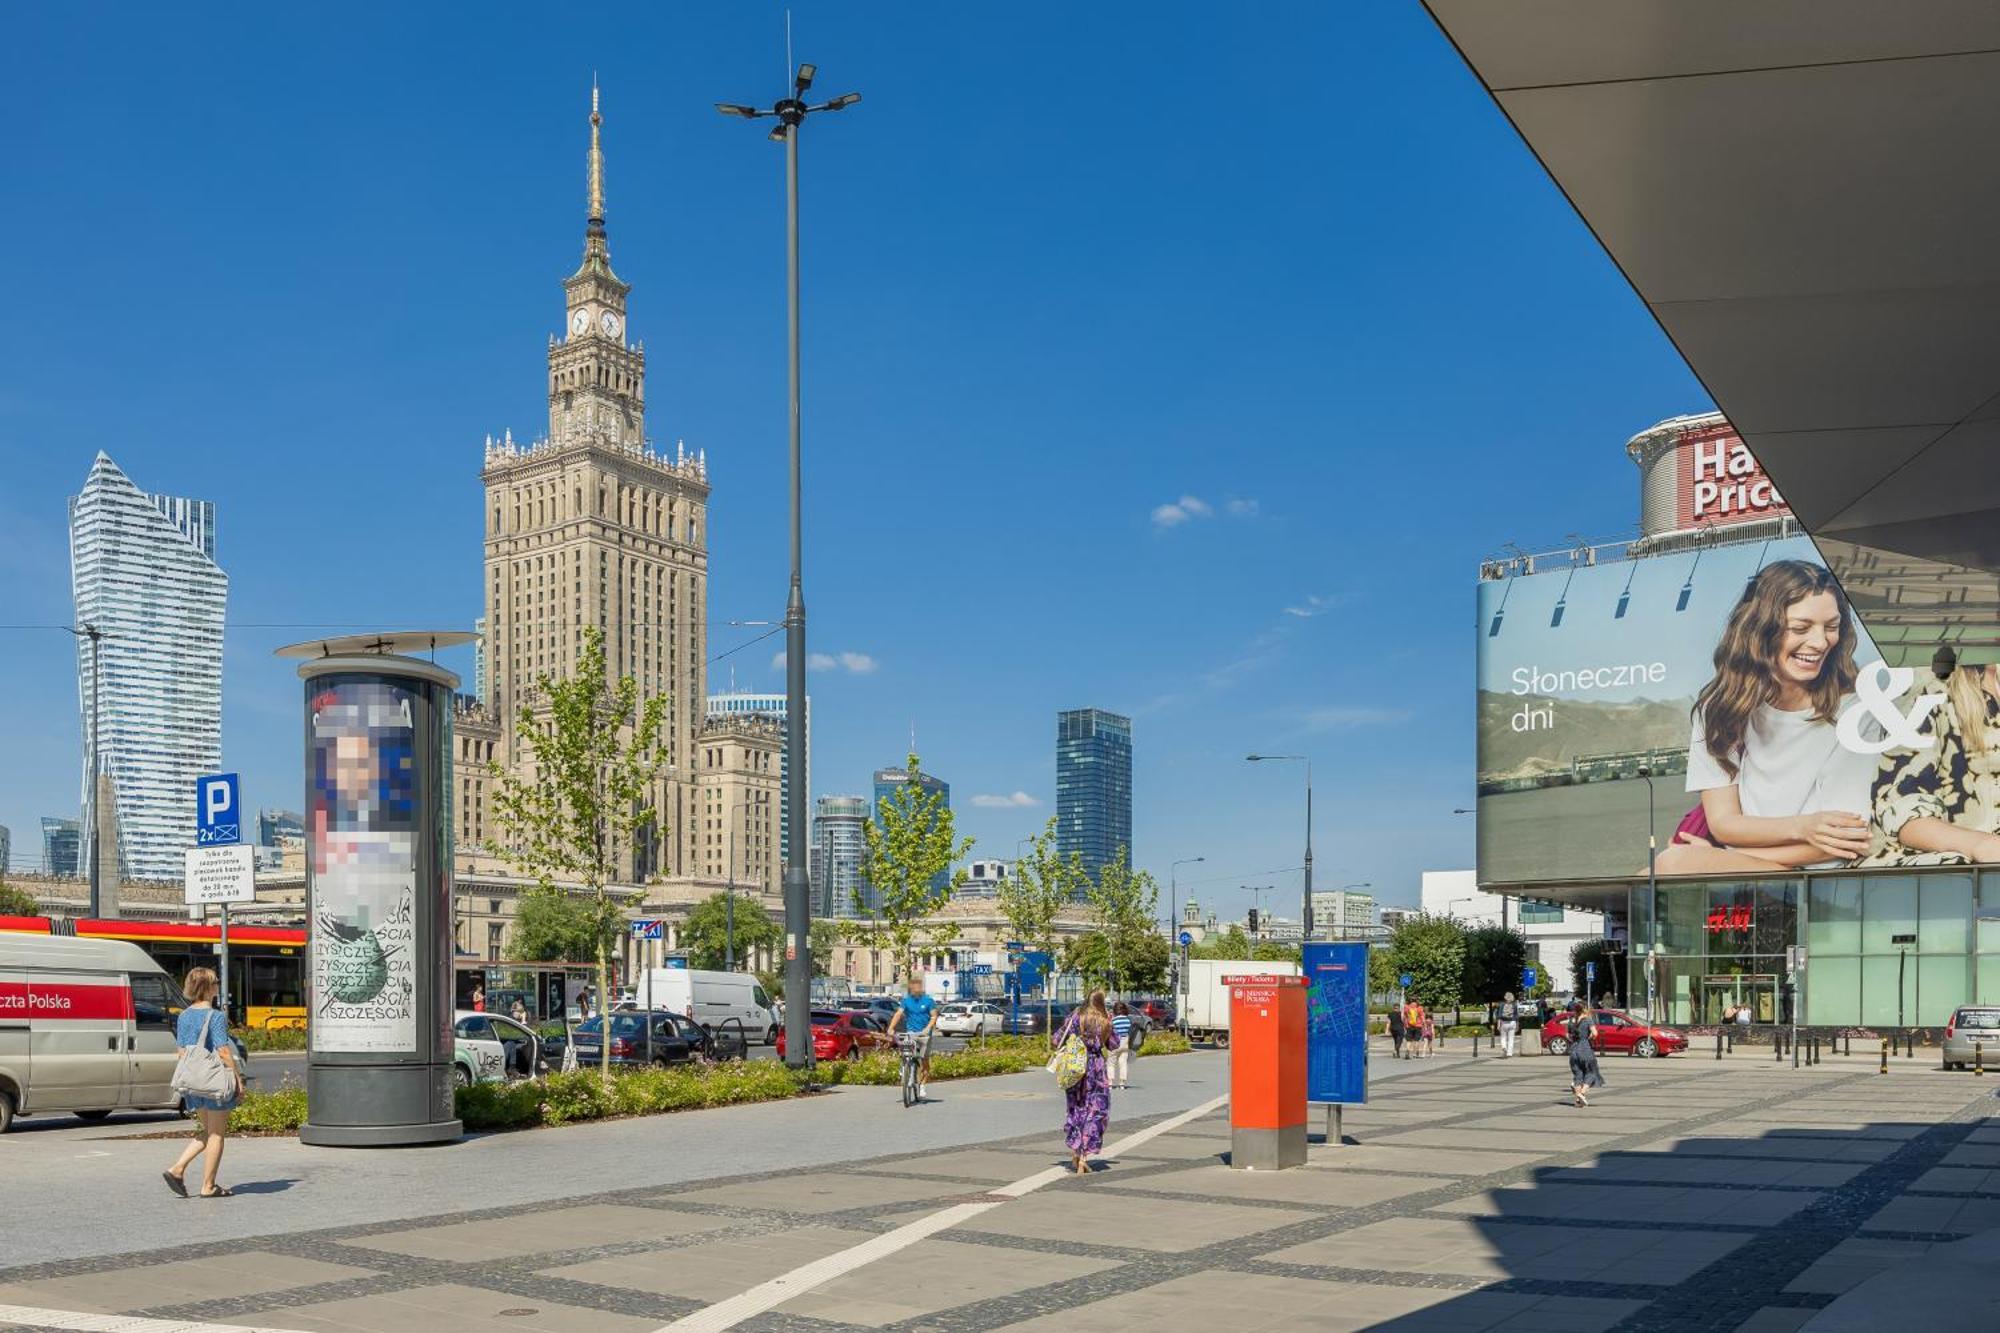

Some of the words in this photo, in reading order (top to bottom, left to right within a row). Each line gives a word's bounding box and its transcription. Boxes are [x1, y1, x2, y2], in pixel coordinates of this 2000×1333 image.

[1511, 661, 1667, 697] Słoneczne
[1511, 703, 1554, 734] dni
[207, 781, 231, 825] P
[29, 994, 71, 1008] Polska
[478, 1051, 504, 1066] Uber
